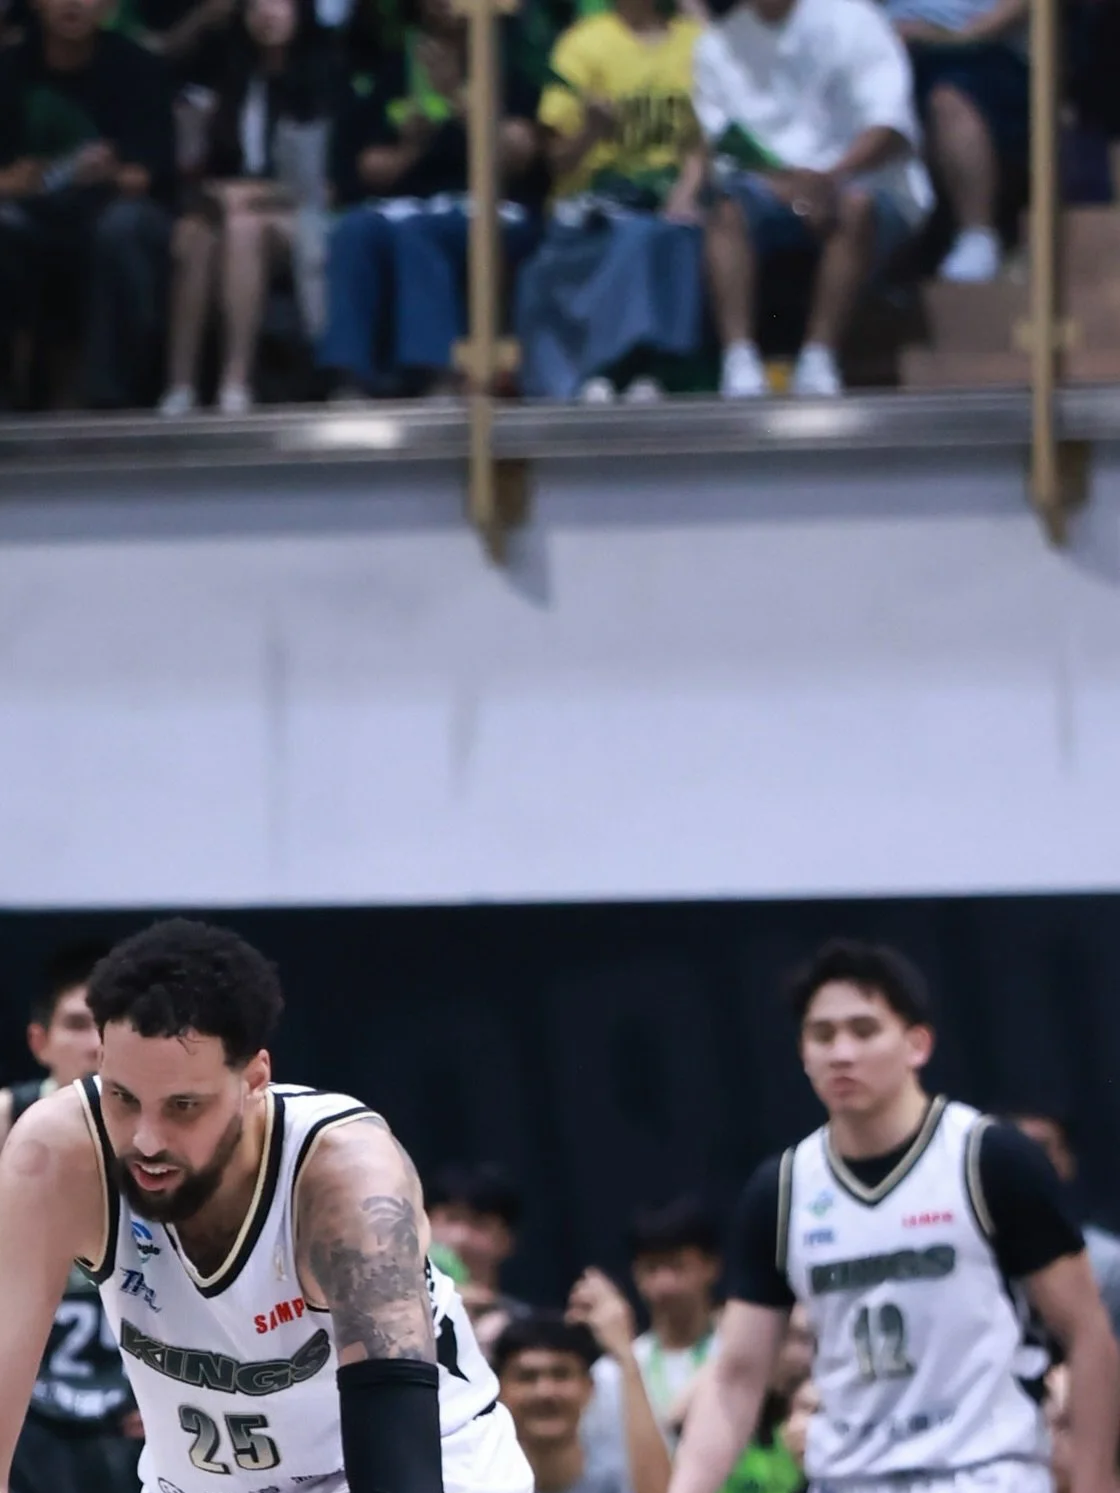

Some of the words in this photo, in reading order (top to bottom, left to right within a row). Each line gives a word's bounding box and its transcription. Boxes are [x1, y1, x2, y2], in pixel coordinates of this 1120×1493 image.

[254, 1297, 306, 1334] SAMP
[853, 1302, 916, 1382] 12
[120, 1317, 332, 1396] KINGS
[178, 1404, 281, 1475] 25
